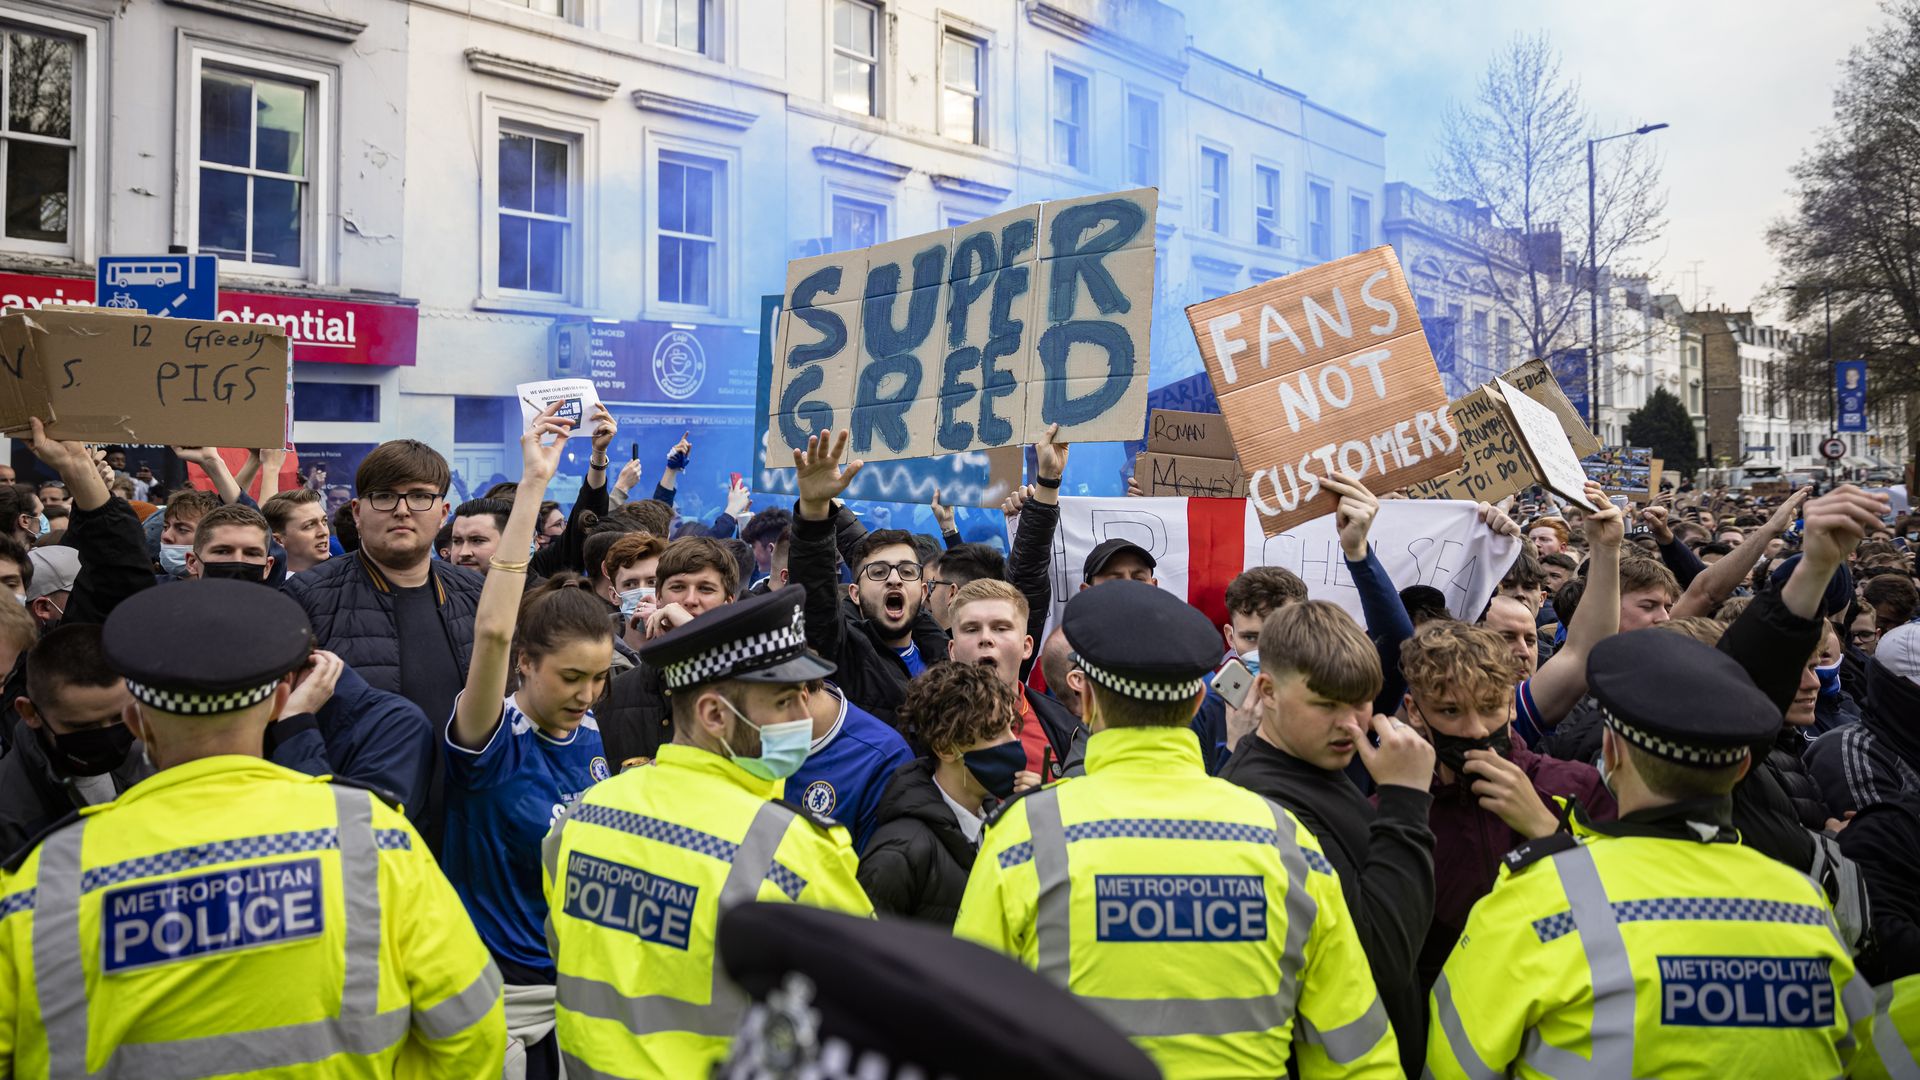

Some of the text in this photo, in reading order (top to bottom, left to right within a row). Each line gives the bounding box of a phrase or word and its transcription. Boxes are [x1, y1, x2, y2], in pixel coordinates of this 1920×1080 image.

[787, 198, 1147, 369] SUPER
[132, 324, 265, 361] 12 Greedy
[1208, 268, 1399, 384] FANS
[157, 362, 270, 406] PIGS
[777, 320, 1137, 455] GREED
[1277, 348, 1392, 433] NOT
[1154, 414, 1206, 442] ROMAN
[1249, 404, 1459, 516] CUSTOMERS
[1474, 442, 1500, 466] FOR
[113, 868, 314, 917] METROPOLITAN
[568, 856, 697, 909] METROPOLITAN
[1098, 878, 1264, 898] METROPOLITAN
[113, 891, 317, 963] POLICE
[565, 875, 690, 945] POLICE
[1099, 900, 1266, 939] POLICE
[1663, 957, 1829, 982] METROPOLITAN
[1664, 983, 1834, 1023] POLICE
